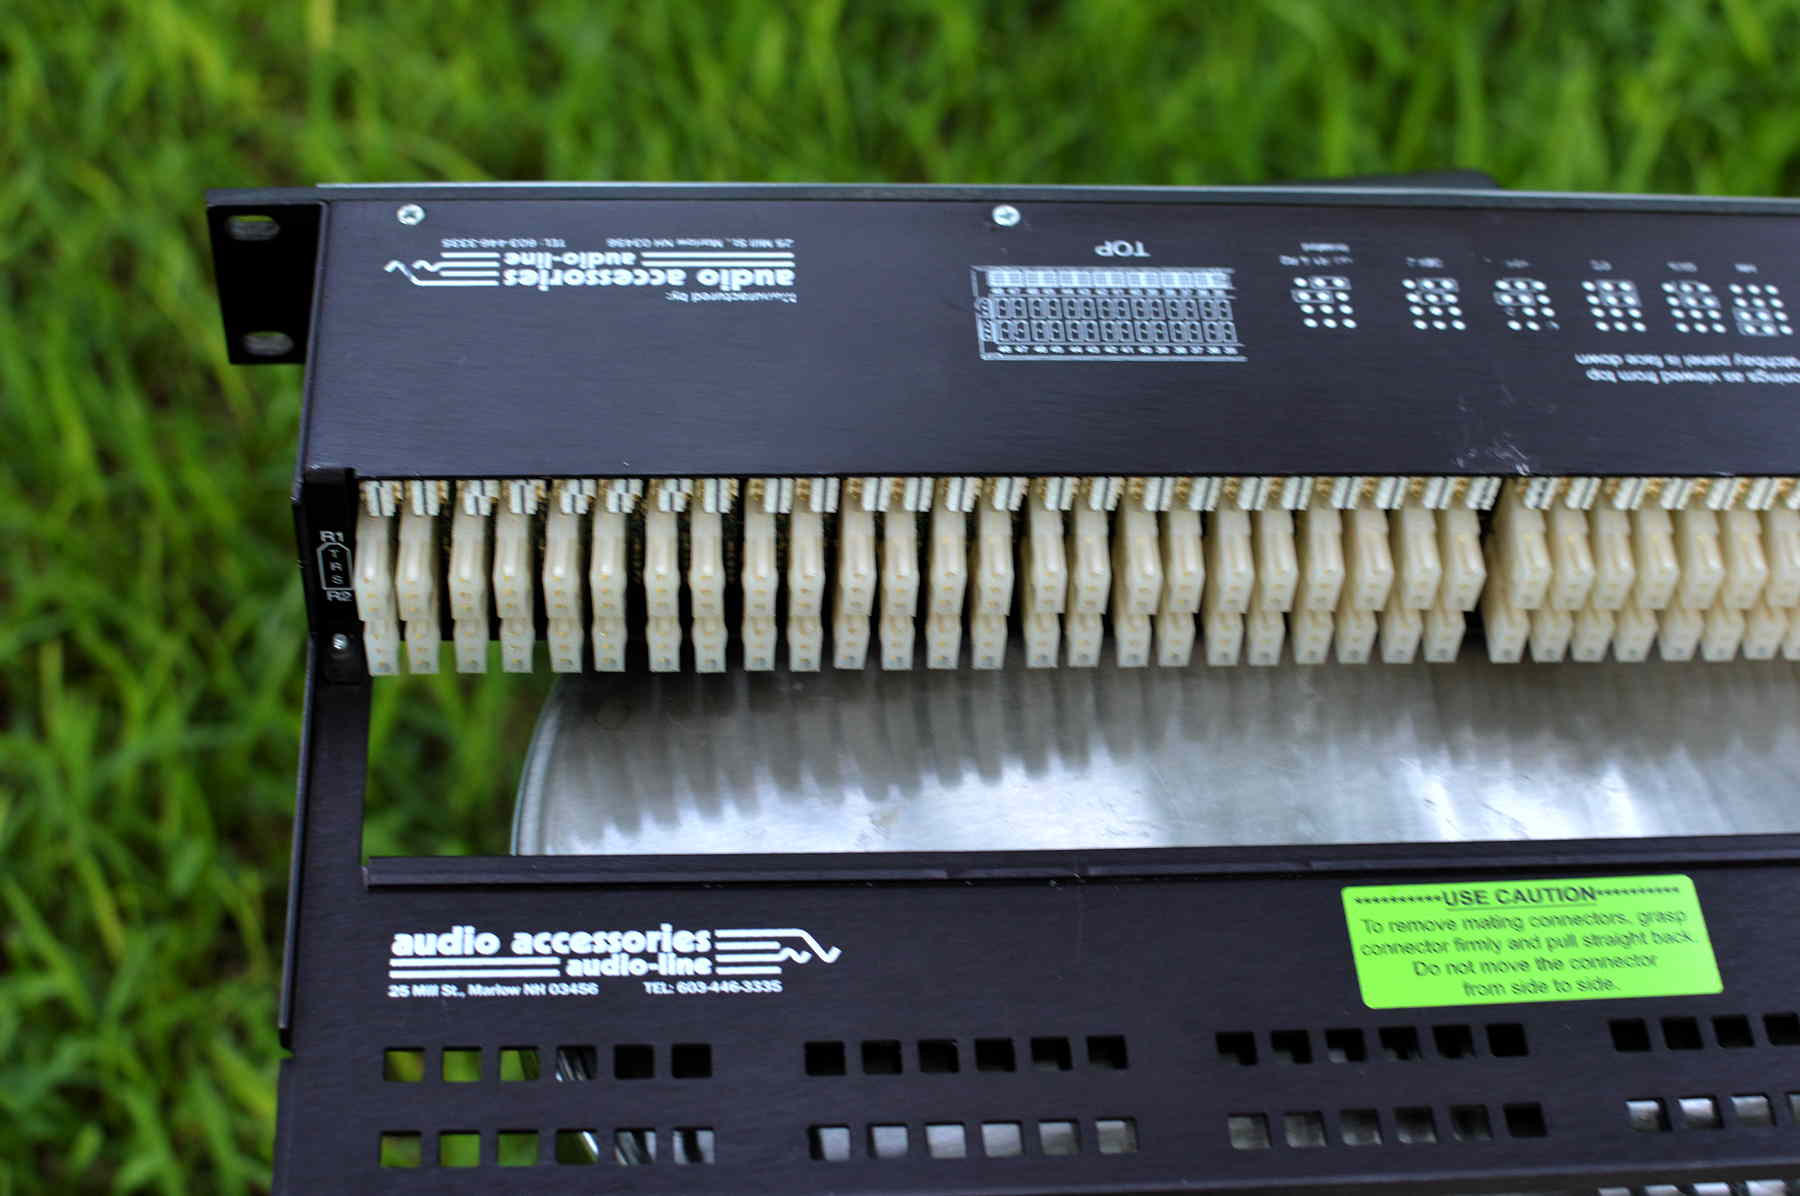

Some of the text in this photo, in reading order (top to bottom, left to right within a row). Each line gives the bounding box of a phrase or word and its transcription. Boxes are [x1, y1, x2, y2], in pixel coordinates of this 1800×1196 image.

[1095, 240, 1150, 256] TOP
[503, 252, 637, 269] audio-line
[503, 268, 796, 292] audio accessories
[1496, 886, 1596, 905] CAUTION
[1361, 917, 1384, 934] To
[1388, 918, 1458, 933] remove
[1463, 915, 1525, 932] mating
[1637, 909, 1687, 926] grasp
[391, 923, 711, 956] audio accessories
[1359, 940, 1450, 957] connector
[1454, 937, 1501, 954] firmly
[1507, 936, 1542, 952] and
[1547, 934, 1579, 951] pull
[1583, 929, 1648, 949] straight
[565, 952, 712, 976] audio-line
[1413, 953, 1658, 977] Do not move the connector
[388, 984, 410, 997] 25
[412, 984, 439, 997] Mill
[468, 984, 521, 996] Marlow
[523, 983, 547, 996] NH
[549, 982, 599, 995] 03456
[644, 980, 783, 994] TEL: 603-446-3335
[1463, 976, 1621, 997] from side to side.
